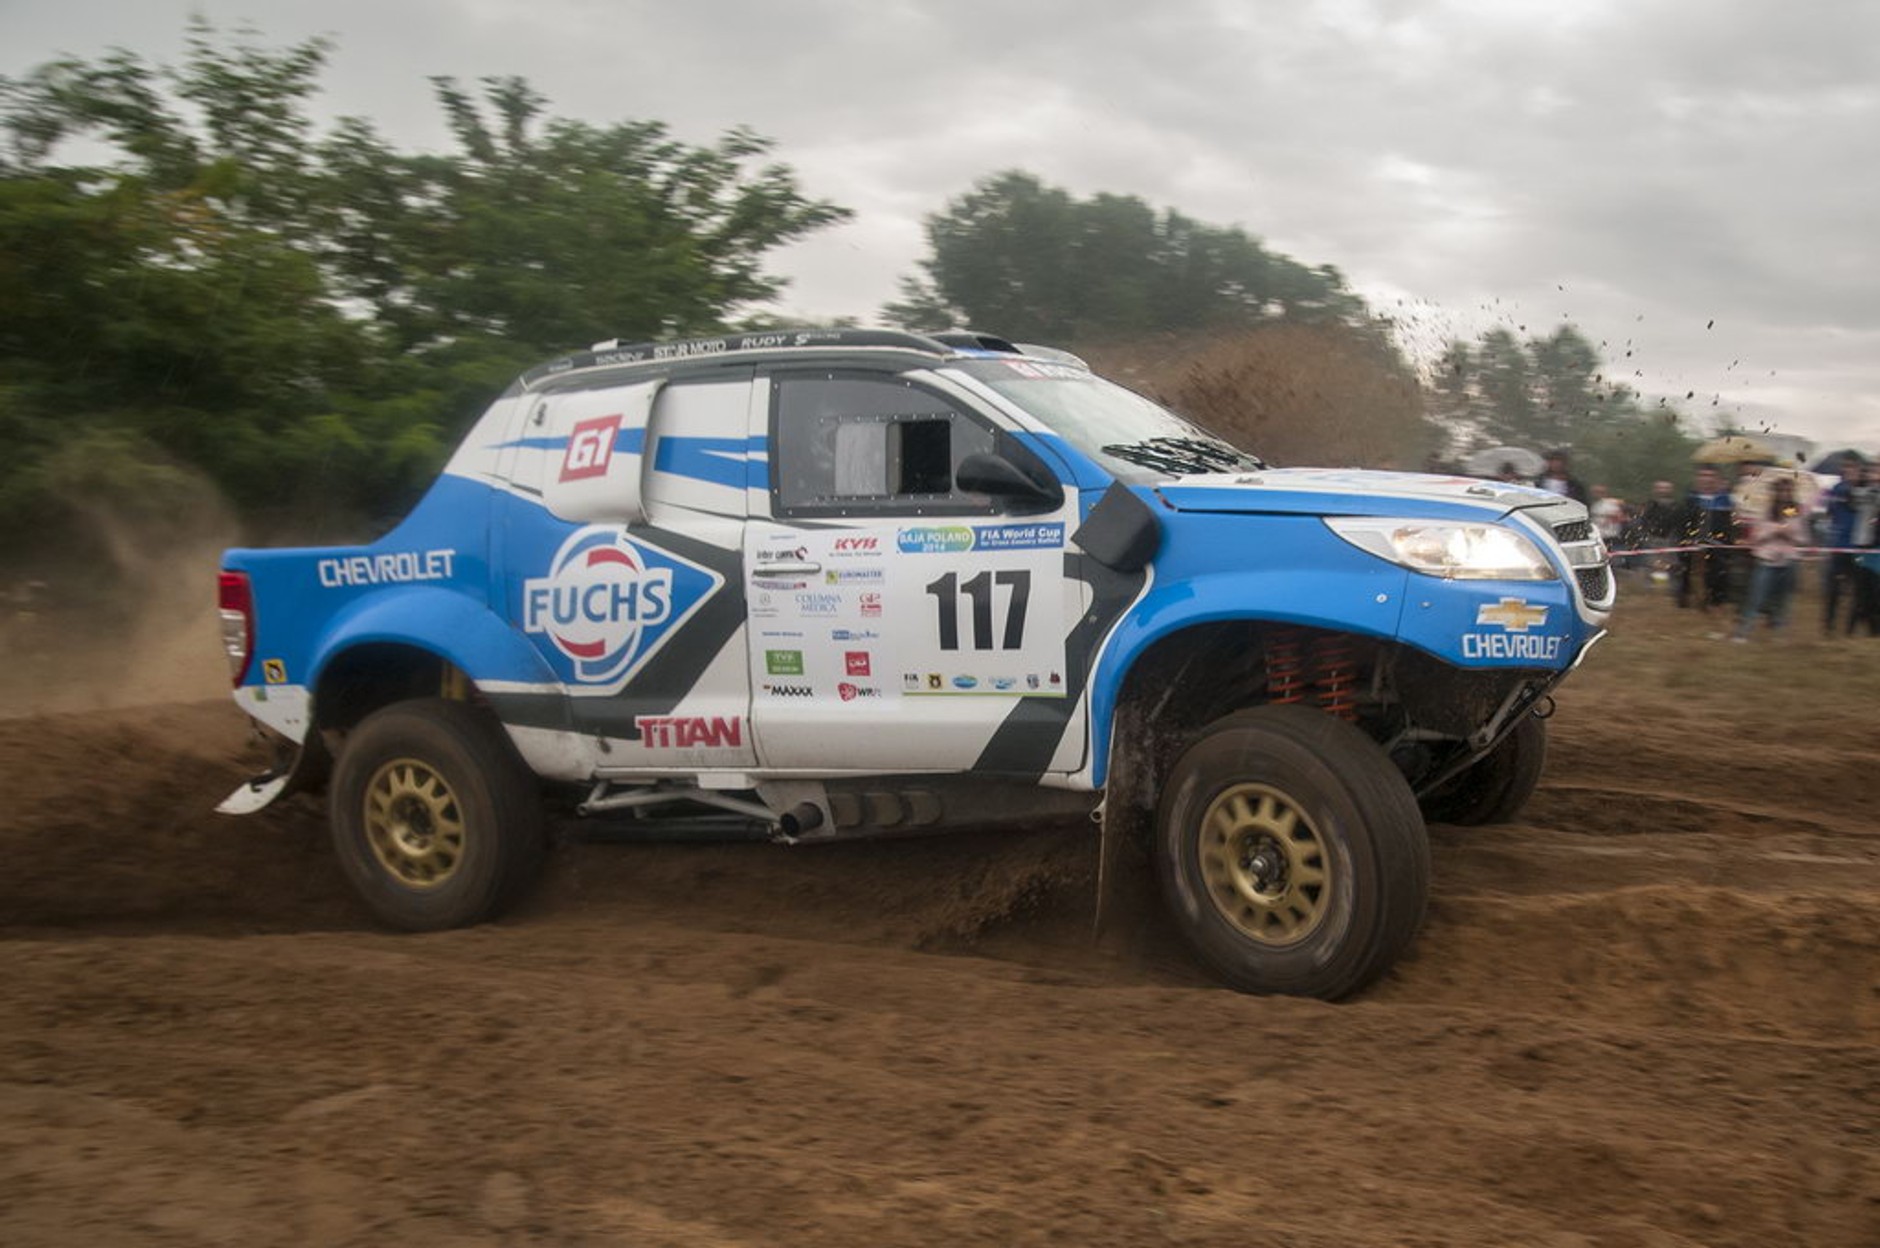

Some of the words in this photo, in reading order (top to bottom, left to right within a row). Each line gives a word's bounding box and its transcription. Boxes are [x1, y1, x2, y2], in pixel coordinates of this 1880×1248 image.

[690, 339, 727, 354] MOTO
[741, 334, 787, 348] RUDY
[926, 531, 970, 543] POLAND
[980, 529, 999, 540] FIA
[1003, 528, 1035, 539] World
[1038, 527, 1061, 539] Cup
[318, 549, 456, 588] CHEVROLET
[529, 579, 666, 627] FUCHS
[926, 570, 1031, 651] 117
[1462, 633, 1561, 659] CHEVROLET
